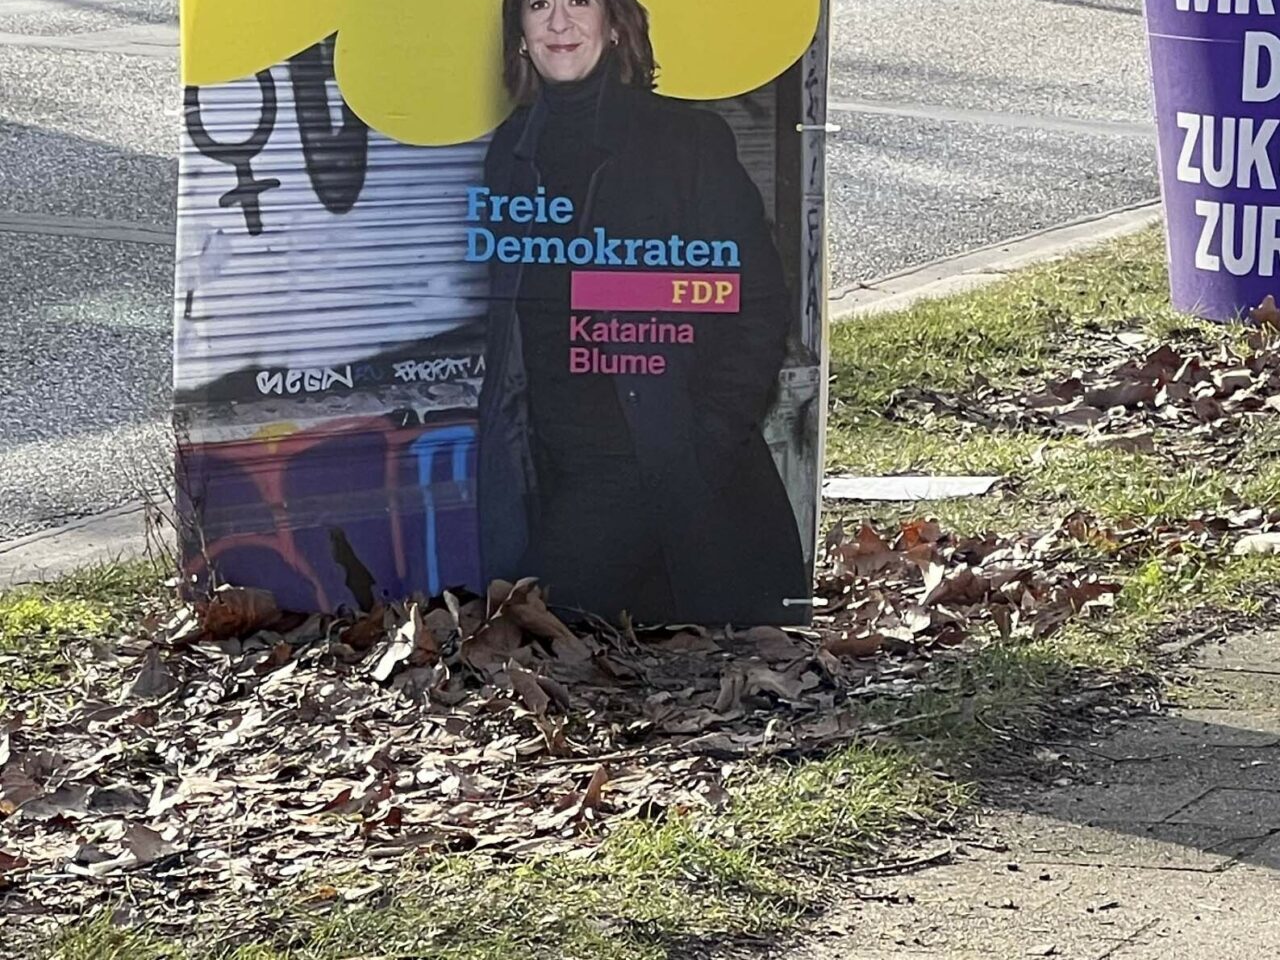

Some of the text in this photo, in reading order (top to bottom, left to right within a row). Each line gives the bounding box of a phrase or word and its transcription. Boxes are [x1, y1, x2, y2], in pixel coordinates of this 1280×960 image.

[465, 186, 574, 224] Freie
[464, 227, 741, 268] Demokraten
[672, 280, 733, 305] FDP
[569, 316, 695, 344] Katarina
[569, 348, 666, 375] Blume
